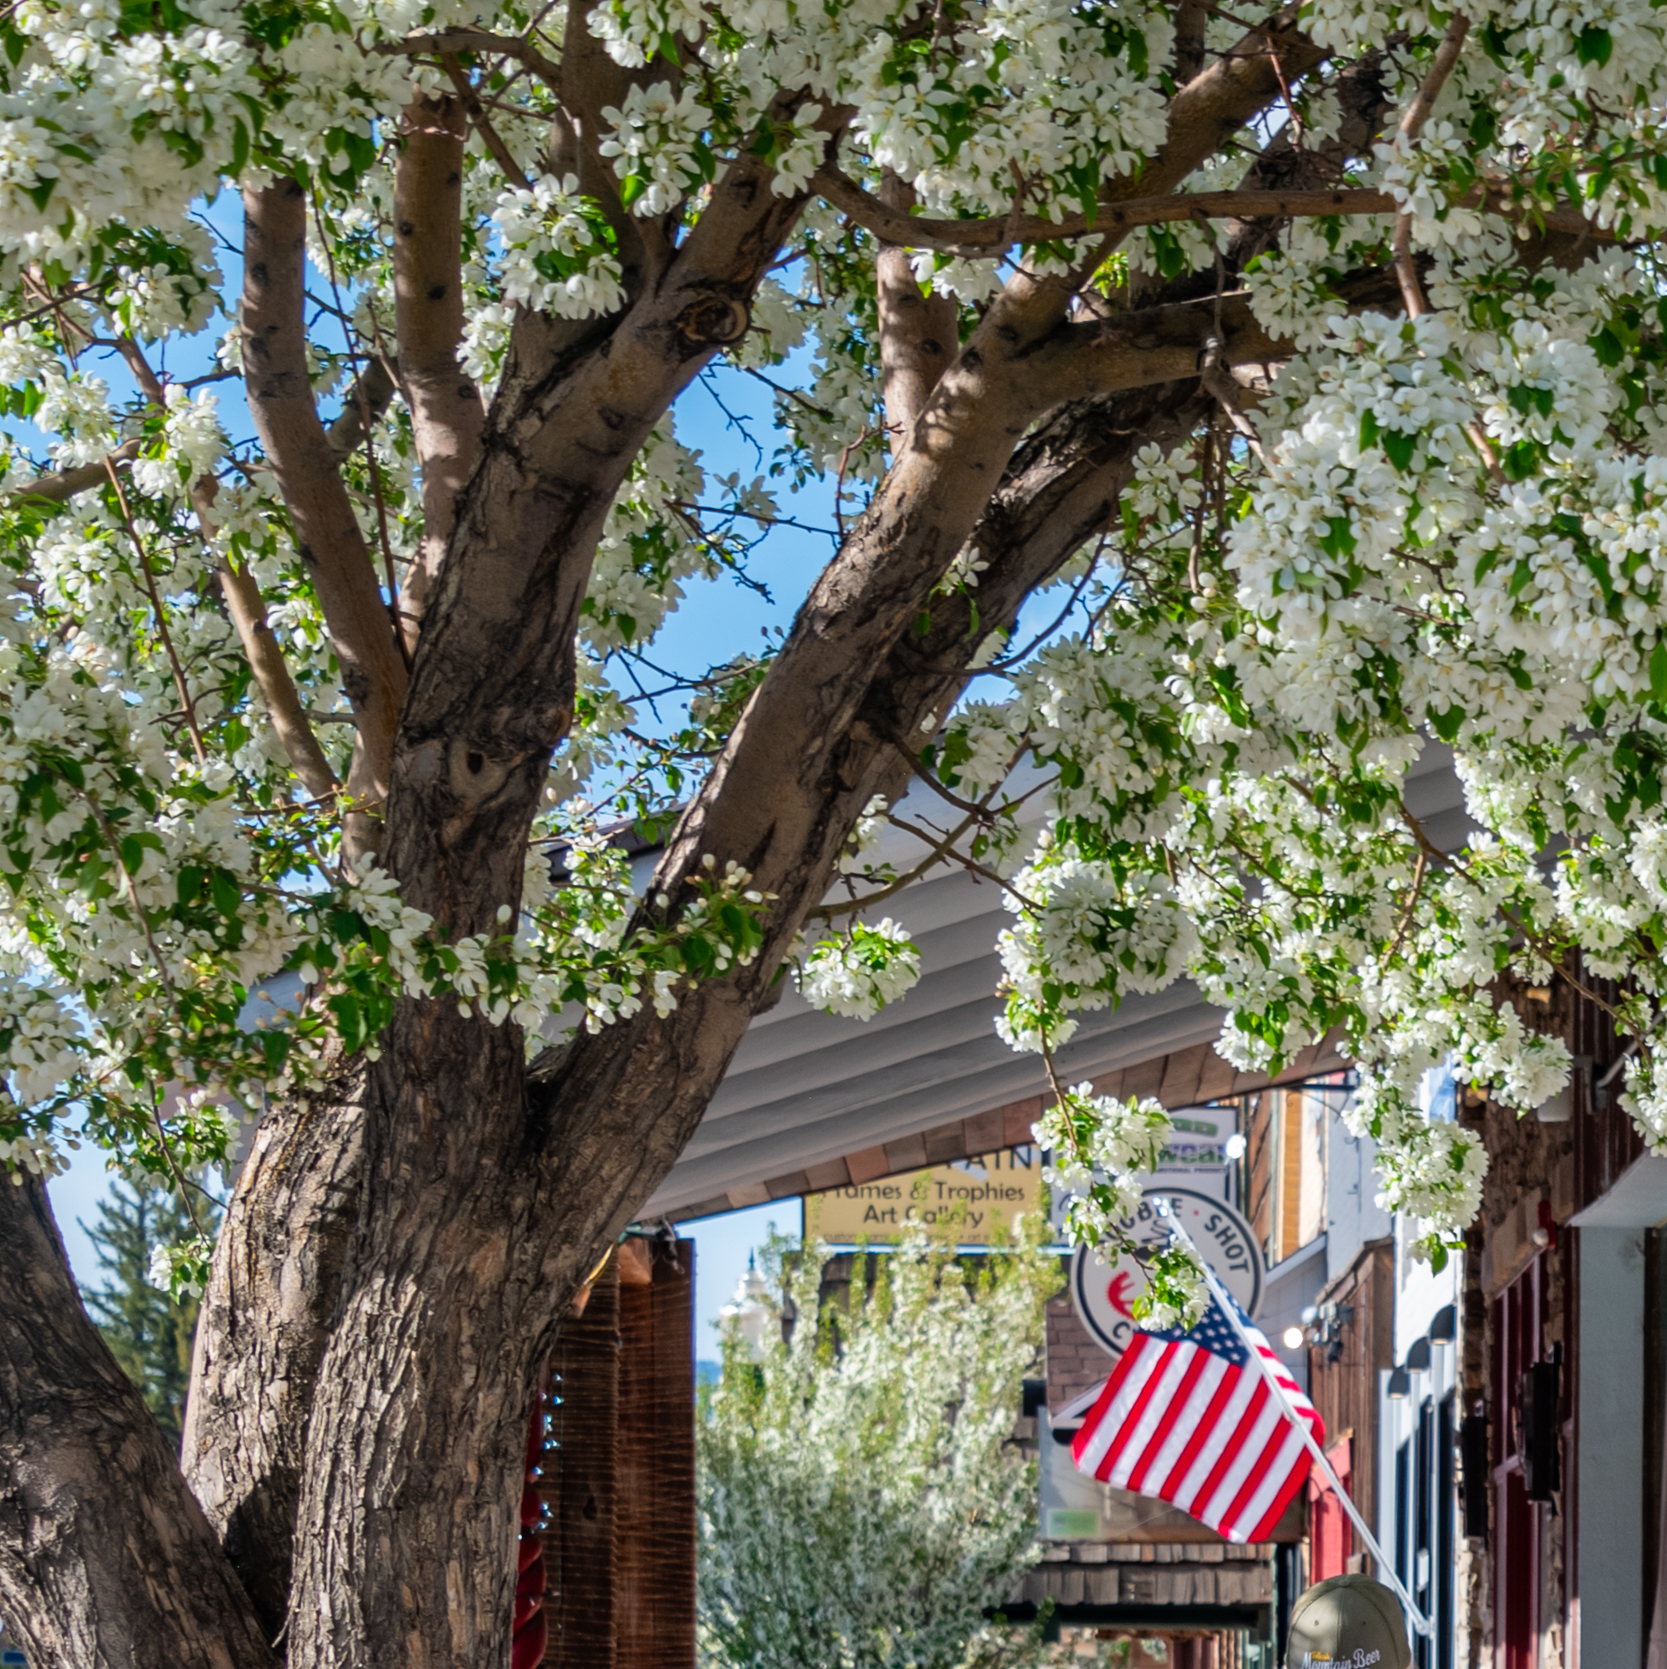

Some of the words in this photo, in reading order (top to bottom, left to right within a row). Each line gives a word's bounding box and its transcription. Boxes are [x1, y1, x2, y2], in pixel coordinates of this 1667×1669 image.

[822, 1184, 902, 1201] rames
[935, 1181, 1025, 1207] Trophies
[863, 1204, 898, 1225] Art
[1203, 1213, 1250, 1274] SHOT
[1353, 1648, 1381, 1669] Beer
